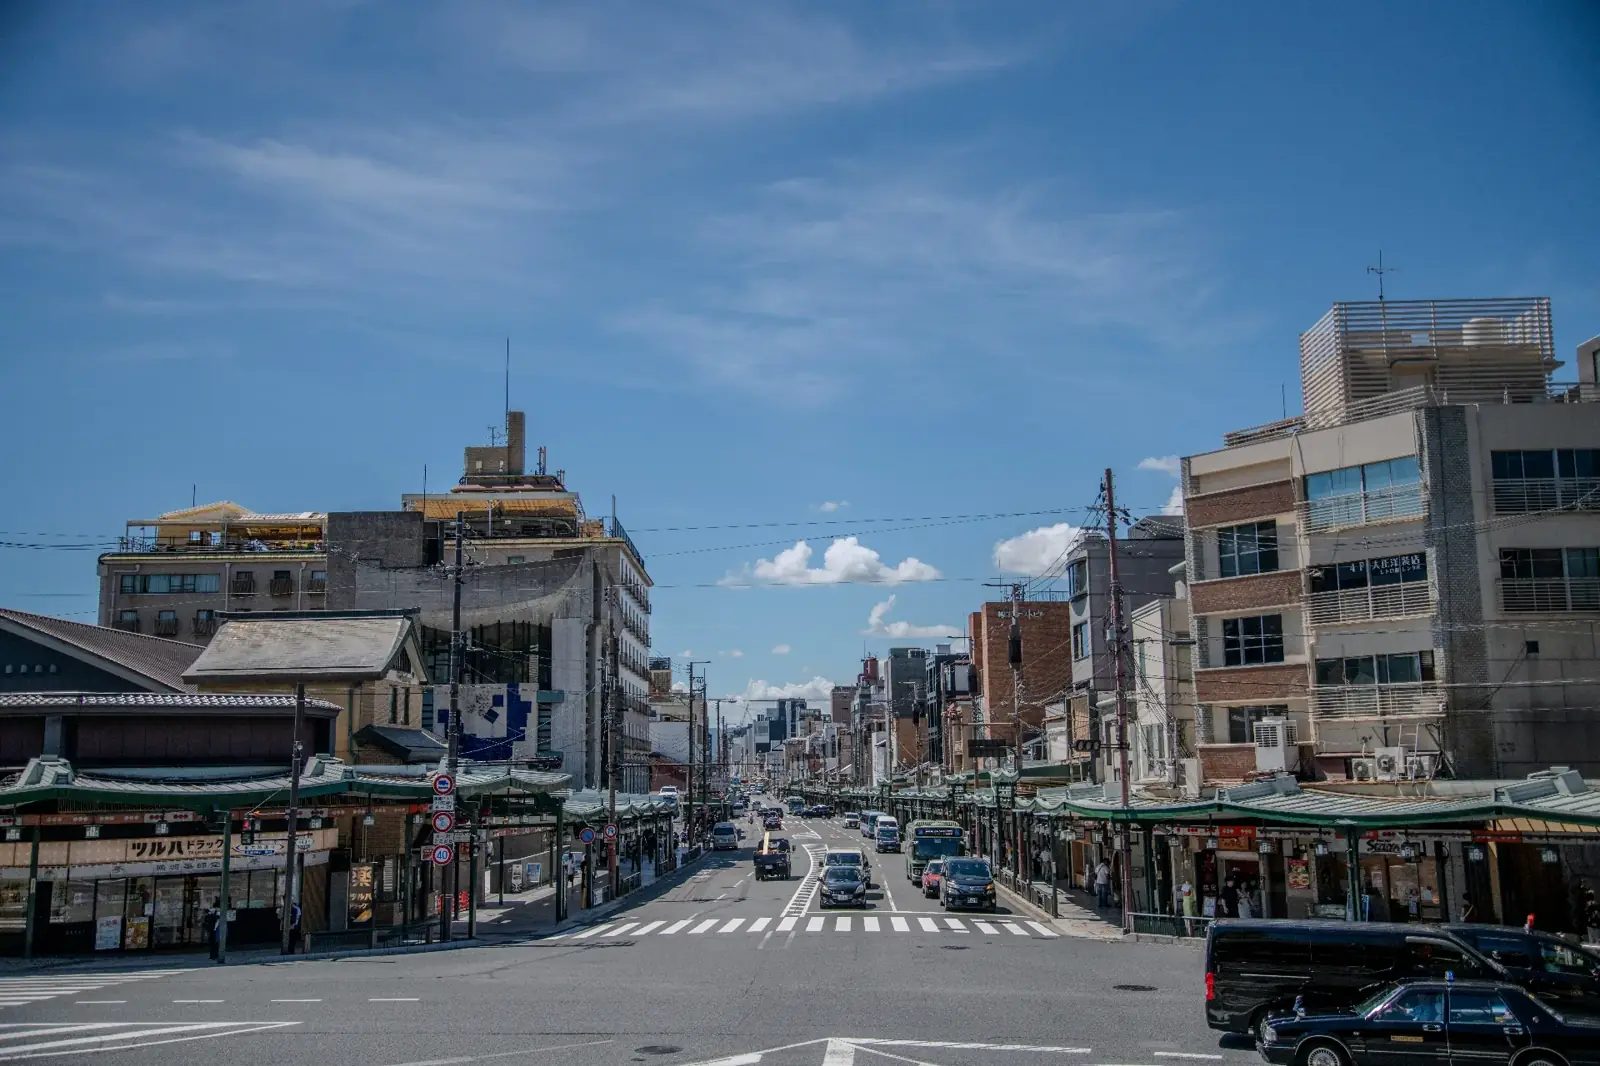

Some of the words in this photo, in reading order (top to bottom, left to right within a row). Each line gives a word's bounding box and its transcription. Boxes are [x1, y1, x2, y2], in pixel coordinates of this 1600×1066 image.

[132, 840, 184, 857] ツルハ
[436, 850, 448, 860] 40
[351, 866, 372, 887] 薬
